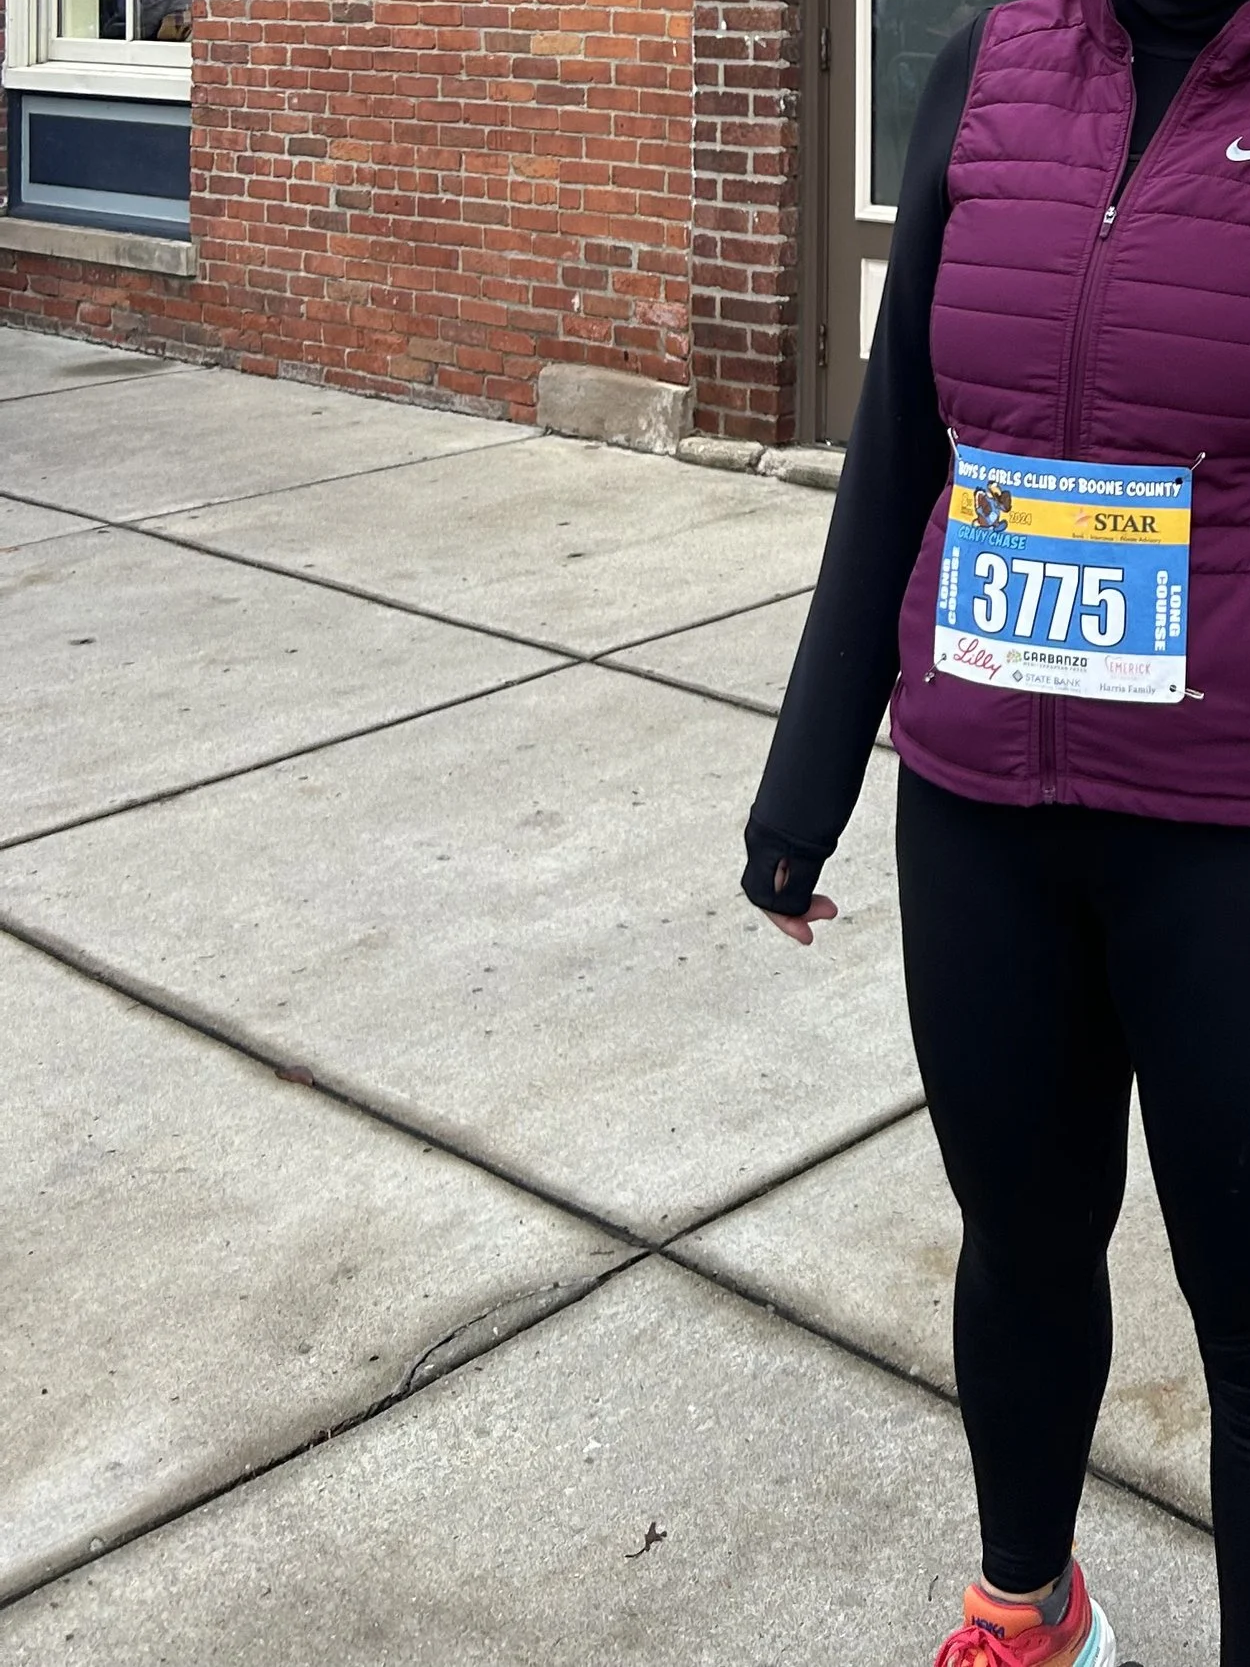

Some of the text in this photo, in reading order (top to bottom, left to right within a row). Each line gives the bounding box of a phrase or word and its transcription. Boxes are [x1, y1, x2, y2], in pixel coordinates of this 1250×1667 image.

[958, 461, 1182, 498] BOYS & GIRLS CLUB OF BOONE COUNTY
[1009, 511, 1032, 525] 2024
[1094, 513, 1159, 533] STAR
[958, 526, 1027, 551] GRAVY CHASE
[973, 551, 1126, 647] 3775
[1155, 570, 1168, 651] COURSE
[1169, 584, 1182, 637] LONG
[953, 637, 1002, 681] Lilly
[1023, 650, 1088, 668] GARBANZO
[1025, 672, 1081, 687] STATE BANK
[1099, 682, 1156, 696] Harris Family
